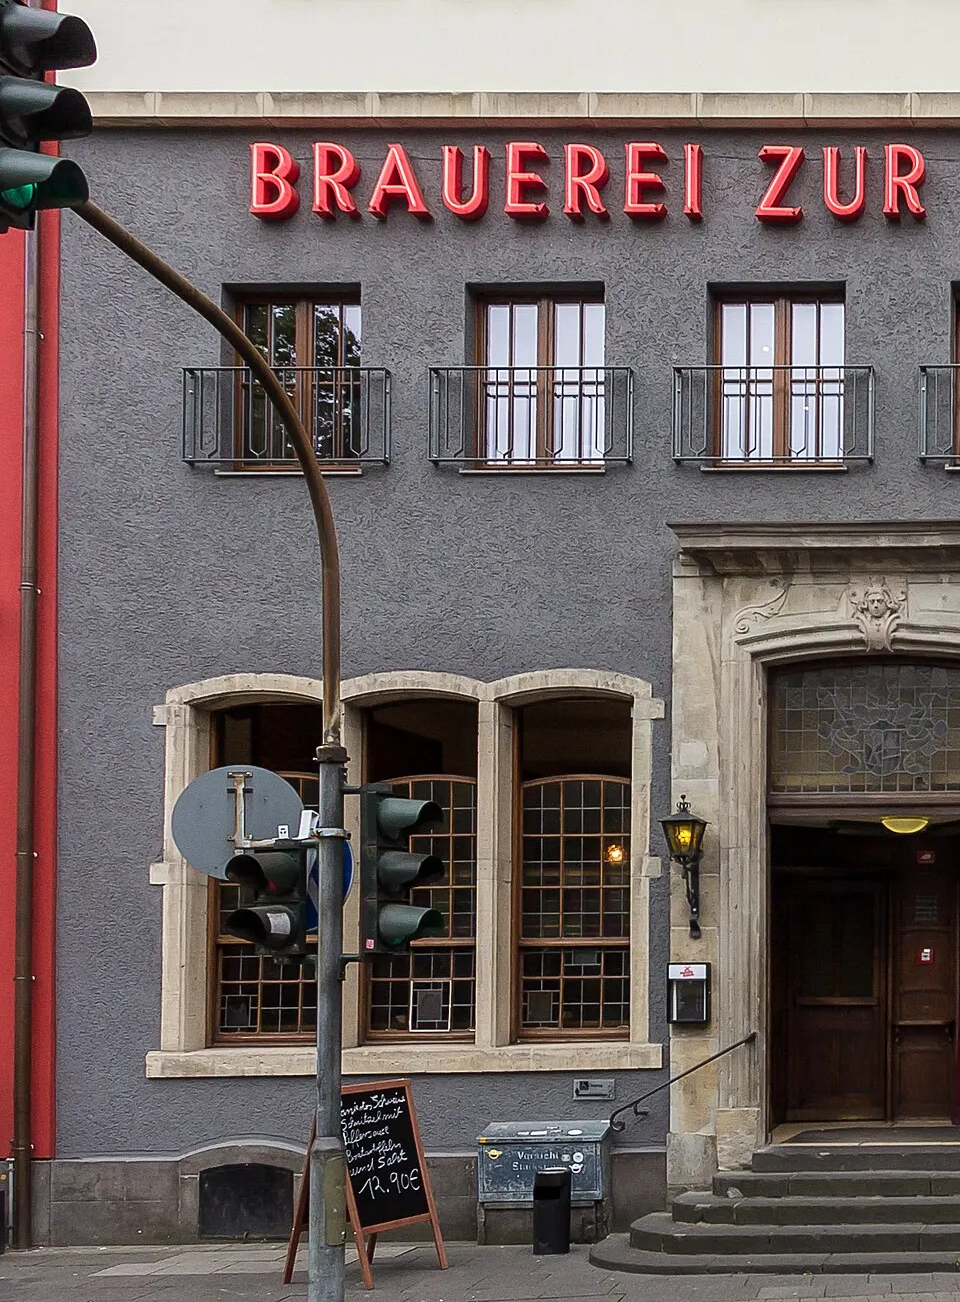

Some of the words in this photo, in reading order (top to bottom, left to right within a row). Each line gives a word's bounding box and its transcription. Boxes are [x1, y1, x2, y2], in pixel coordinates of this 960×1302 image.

[249, 142, 704, 220] BRAUEREI
[755, 143, 927, 223] ZUR
[382, 1106, 404, 1120] mit
[358, 1168, 421, 1200] 12.90€
